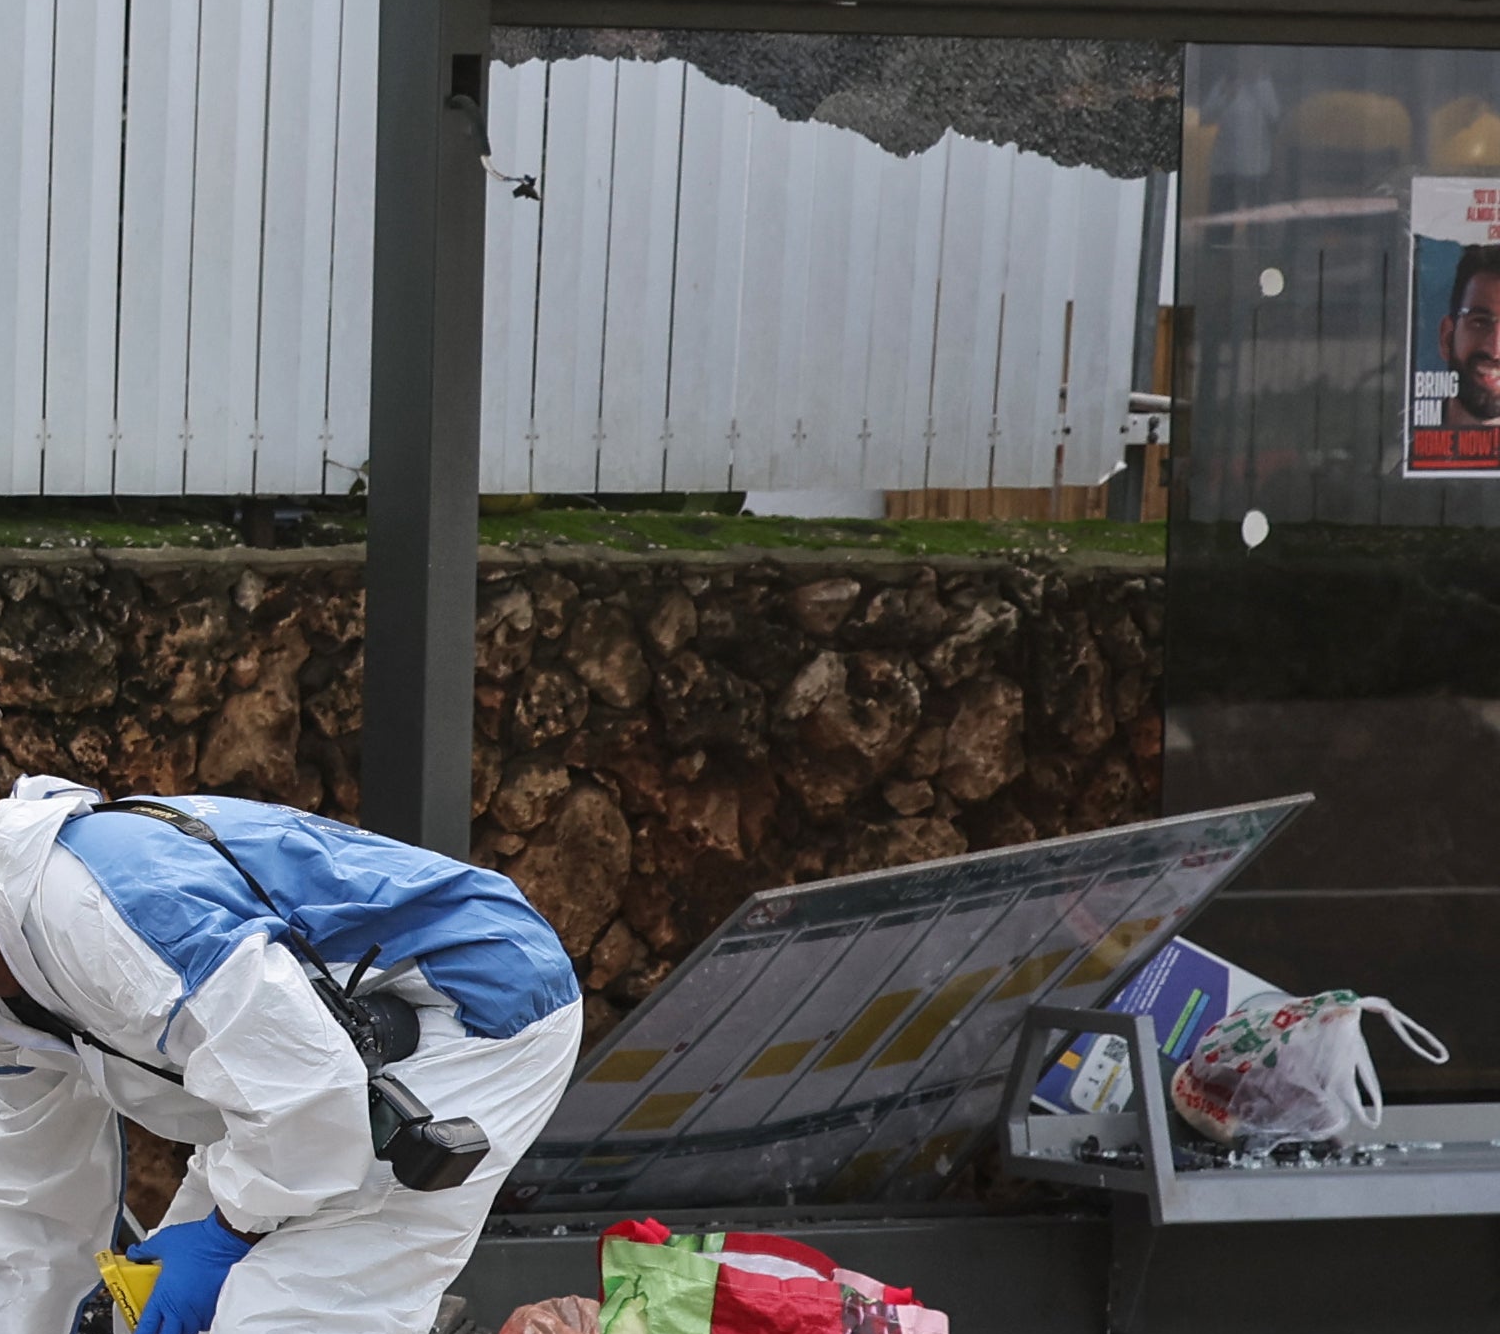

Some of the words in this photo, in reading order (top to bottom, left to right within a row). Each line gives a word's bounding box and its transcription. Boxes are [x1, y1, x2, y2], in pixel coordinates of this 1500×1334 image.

[1414, 371, 1459, 398] BRING
[1414, 399, 1442, 426] HIM
[1414, 430, 1454, 457] HOME
